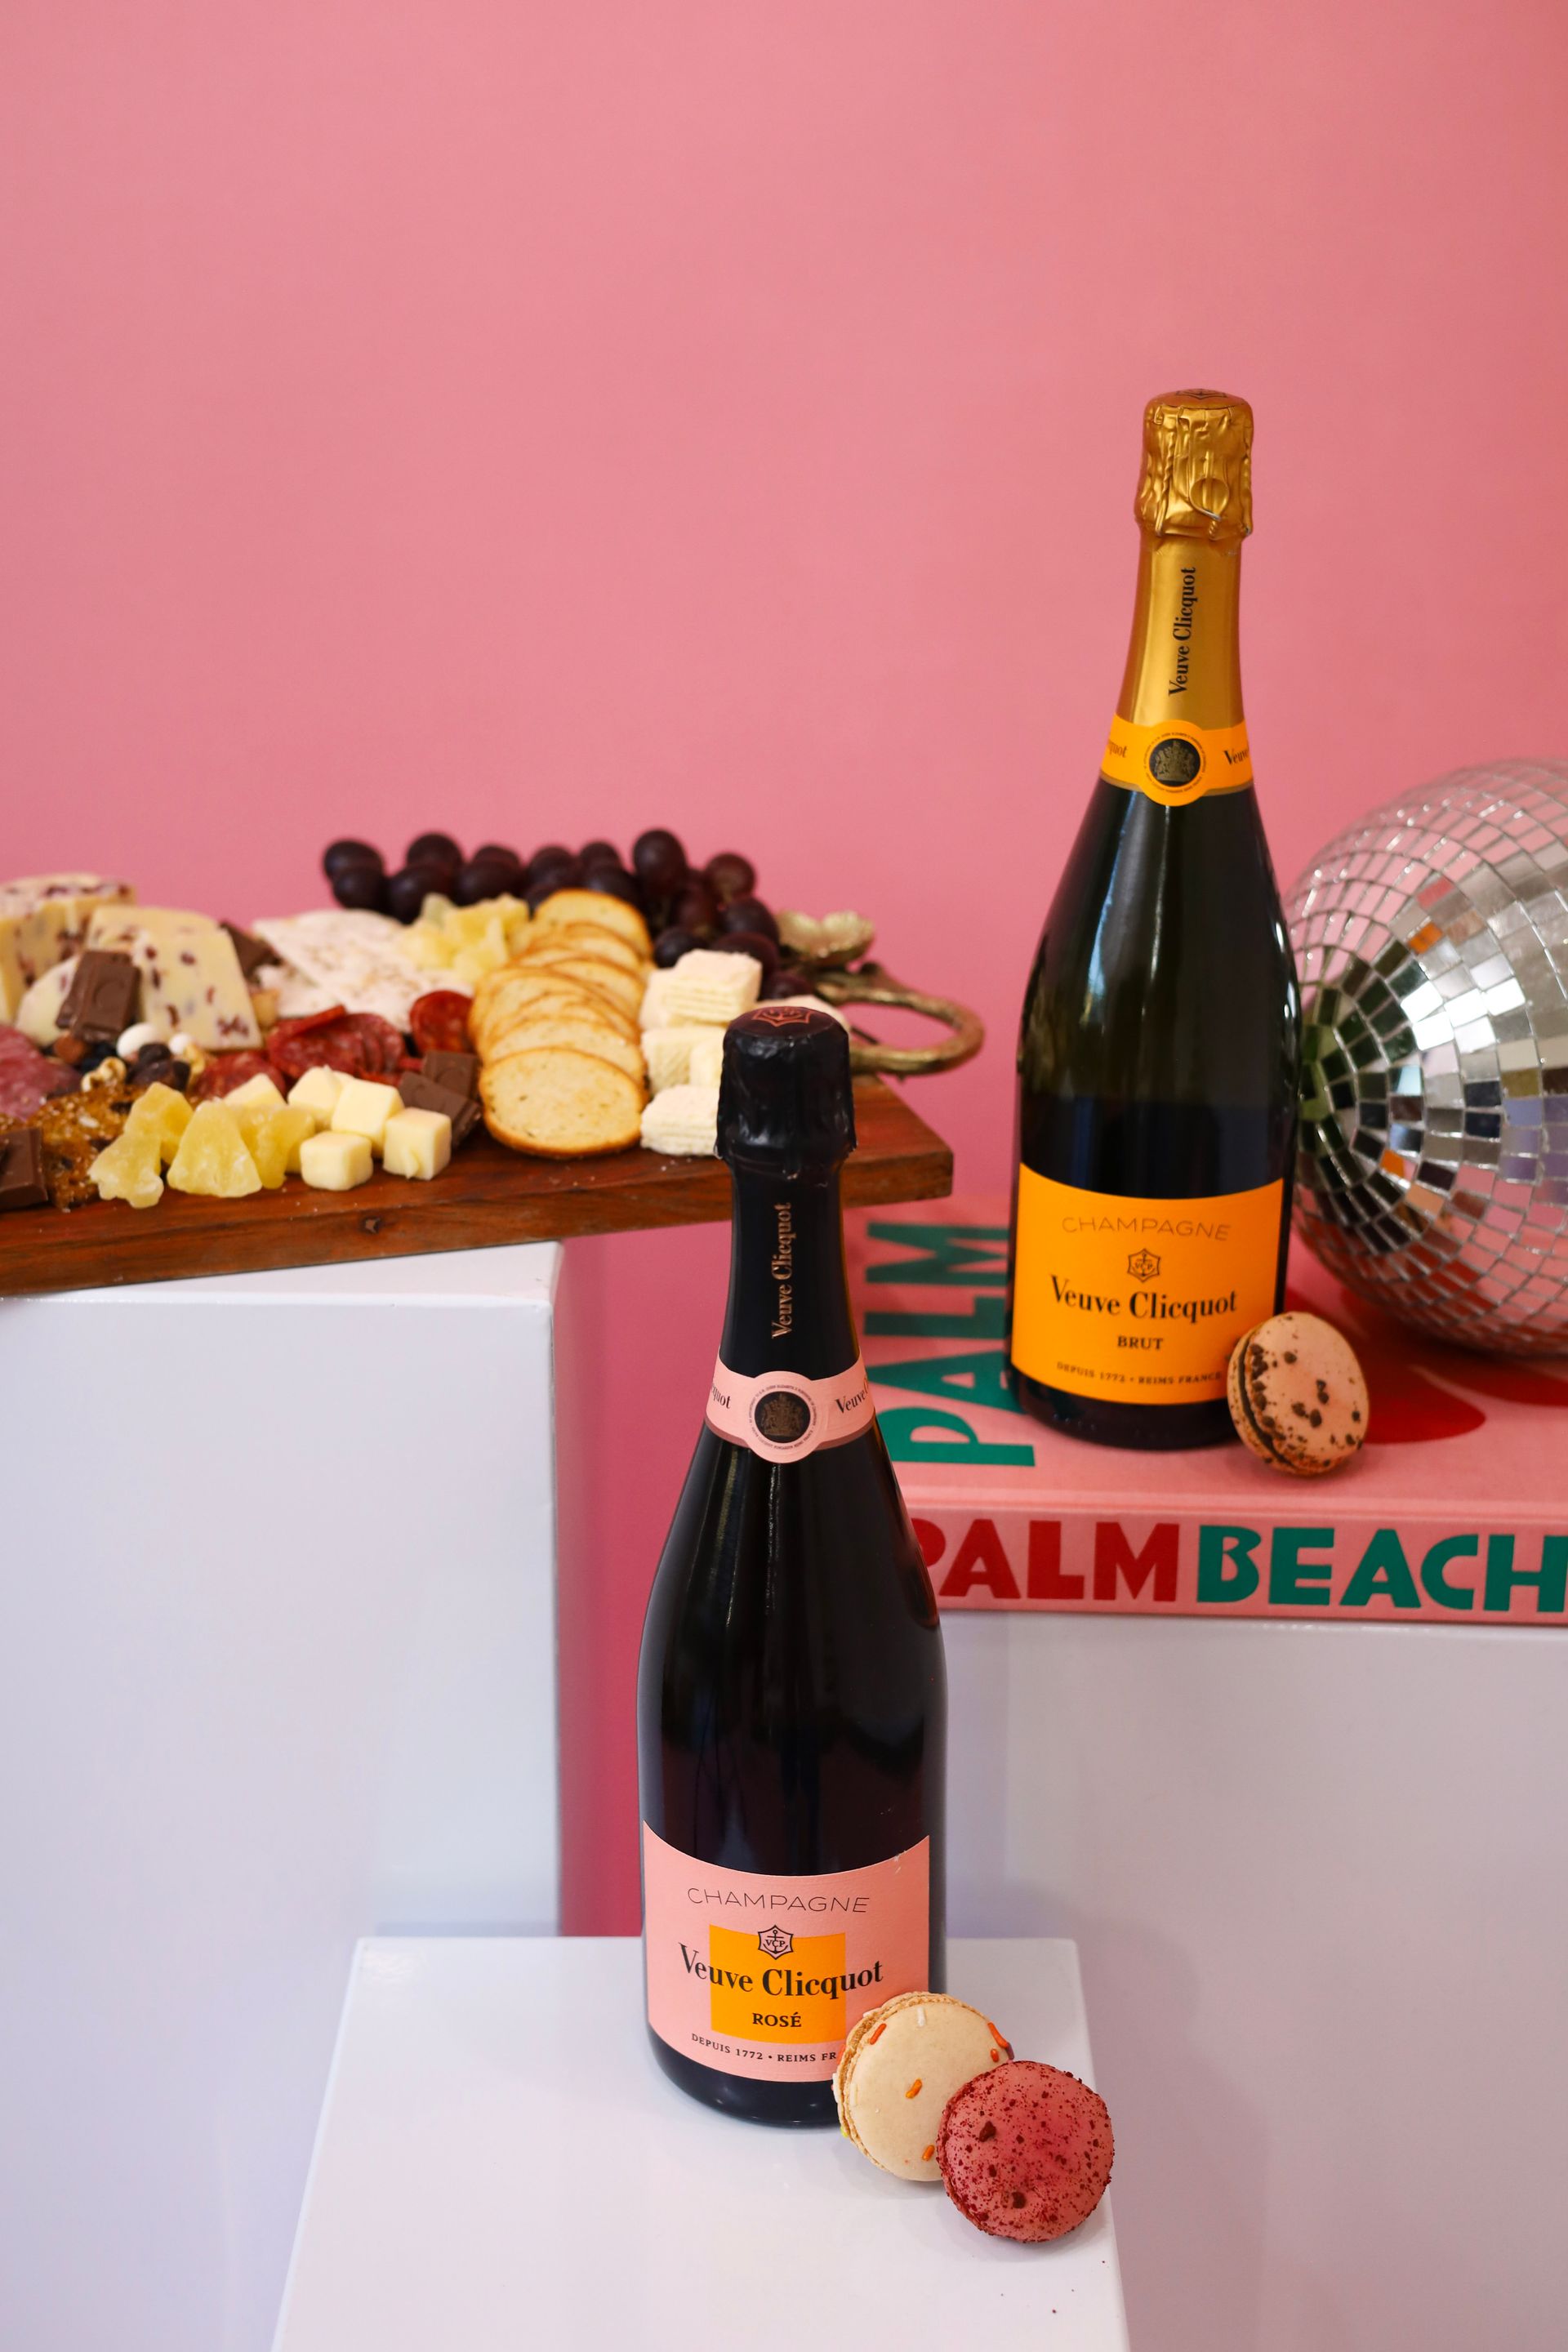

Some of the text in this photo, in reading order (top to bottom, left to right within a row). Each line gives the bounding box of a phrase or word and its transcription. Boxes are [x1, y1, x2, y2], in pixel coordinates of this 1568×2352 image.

[1168, 566, 1198, 697] Veuve Clicquot
[1108, 738, 1127, 758] quot
[1062, 1216, 1232, 1241] CHAMPAGNE
[771, 1201, 797, 1339] Veuve Clicquot
[1049, 1274, 1238, 1325] Veuve Clicquot
[863, 1221, 1036, 1467] PALM
[1116, 1334, 1165, 1350] BRUT
[1056, 1361, 1223, 1385] DEPUIS 1772 REIMS FRANCE
[834, 1389, 866, 1414] Veuve
[1196, 1524, 1568, 1614] BEACH
[687, 1887, 871, 1913] CHAMPAGNE
[765, 1939, 786, 1948] VCP
[678, 1942, 884, 2000] Veuve Clicquot
[751, 2011, 803, 2028] ROSÉ
[691, 2033, 731, 2054] DEPUIS
[735, 2048, 764, 2060] 1772
[777, 2053, 816, 2062] REIMS
